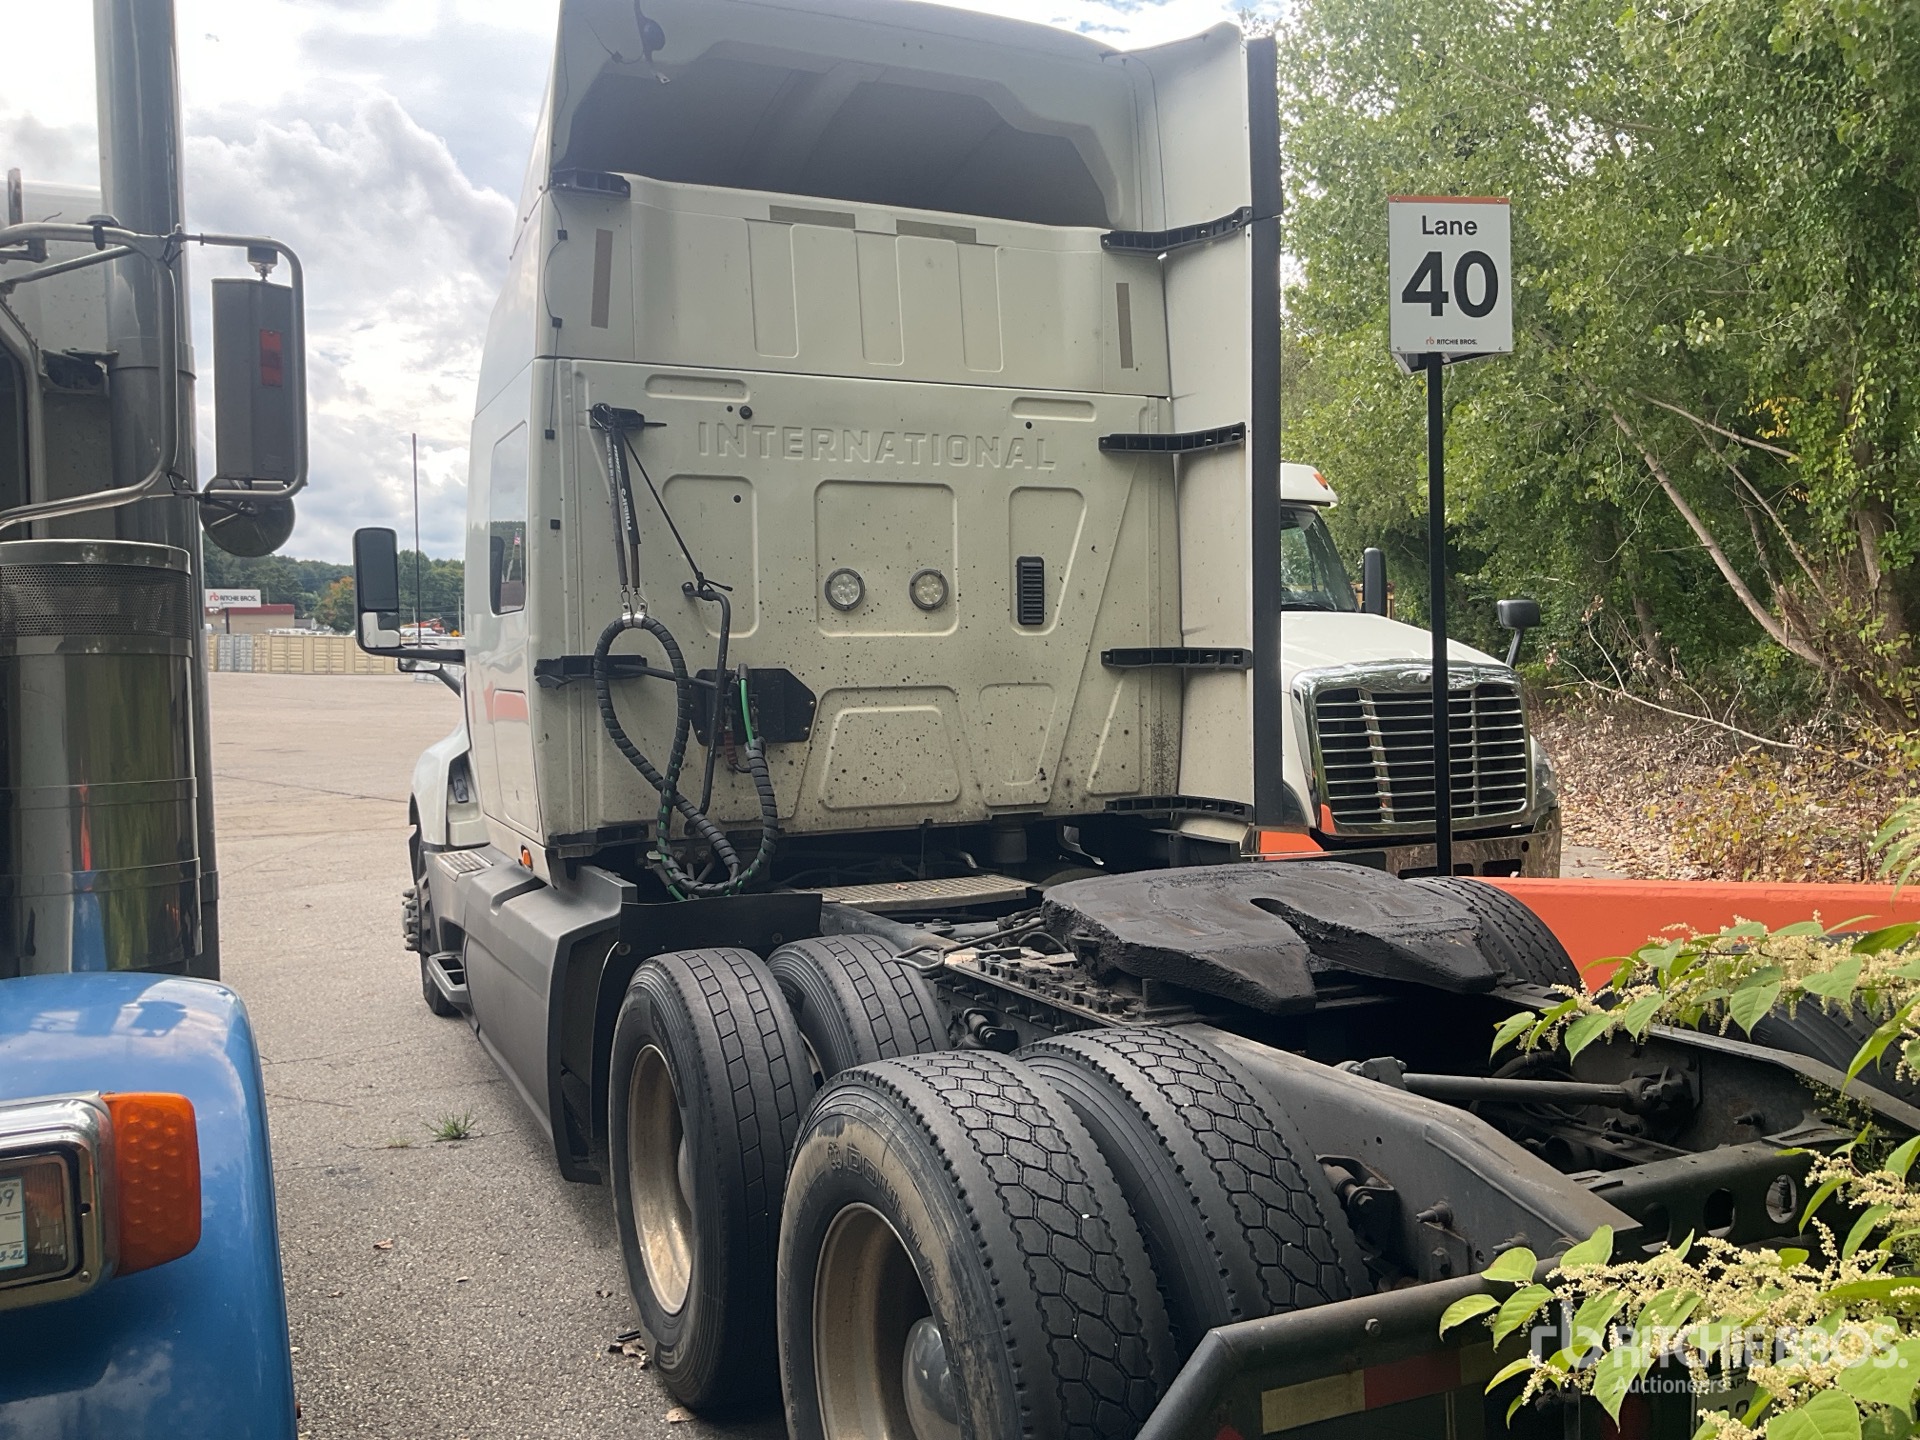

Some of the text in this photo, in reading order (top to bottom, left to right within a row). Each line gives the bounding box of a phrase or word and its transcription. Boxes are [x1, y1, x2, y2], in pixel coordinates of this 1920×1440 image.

[1422, 215, 1477, 236] Lane
[1402, 250, 1498, 318] 40
[697, 421, 1056, 470] INTERNATIONAL
